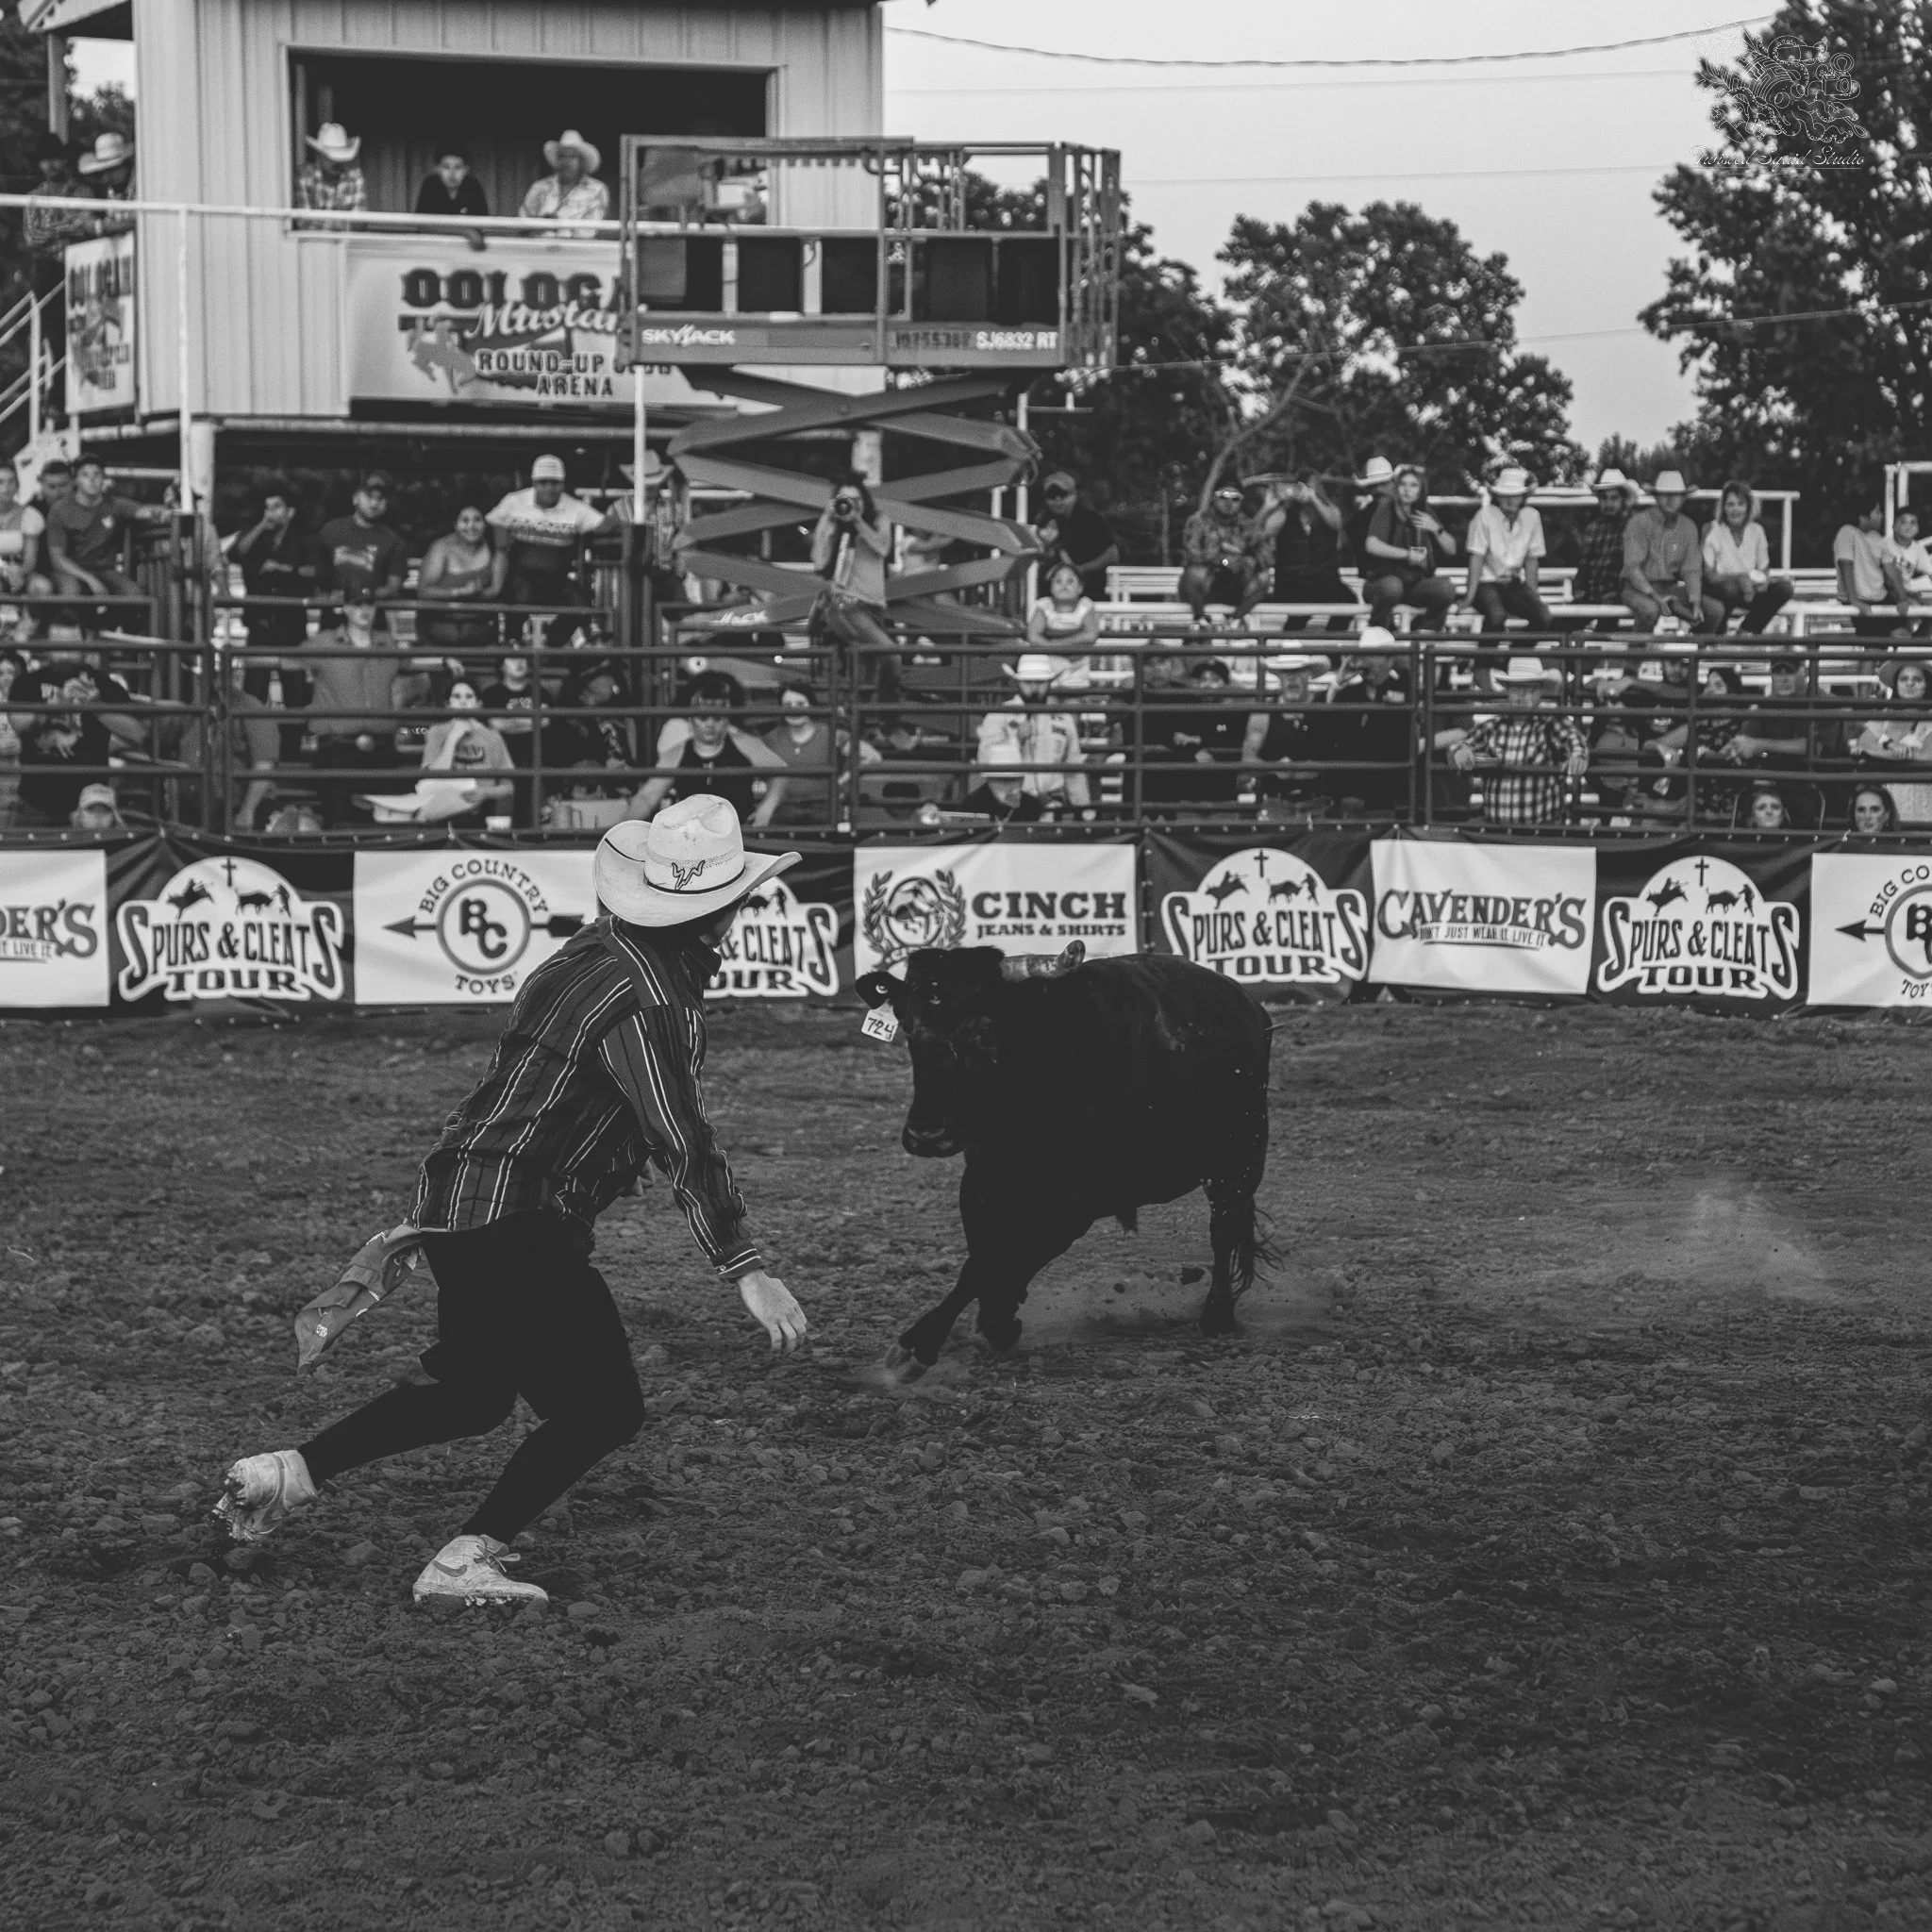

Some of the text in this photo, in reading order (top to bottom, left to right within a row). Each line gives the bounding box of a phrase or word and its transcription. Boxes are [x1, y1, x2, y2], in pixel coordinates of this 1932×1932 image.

[641, 324, 736, 347] SKYJACK
[1036, 331, 1058, 350] RT
[475, 348, 606, 376] ROUND-UP
[537, 375, 613, 397] ARENA
[419, 858, 550, 914] BIG COUNTRY
[972, 891, 1126, 920] CINCH
[1869, 879, 1899, 918] BIG
[1376, 889, 1588, 950] CAVENDER'S
[976, 924, 1126, 940] JEANS & SHIRTS
[1167, 892, 1363, 972] SPURS & CLEATS
[1444, 925, 1470, 941] JUST
[1473, 925, 1500, 941] WEAR
[1512, 928, 1533, 944] LIVE
[1535, 932, 1546, 947] IT
[123, 905, 338, 991] SPURS & CLEATS
[742, 907, 832, 987] CLEATS
[1604, 901, 1793, 990] SPURS & CLEATS
[1208, 955, 1331, 976] TOUR
[1641, 965, 1760, 990] TOUR
[166, 969, 295, 991] TOUR
[455, 974, 516, 995] TOYS
[708, 970, 796, 990] OUR
[1901, 978, 1932, 1000] TOY
[867, 1017, 896, 1041] 724
